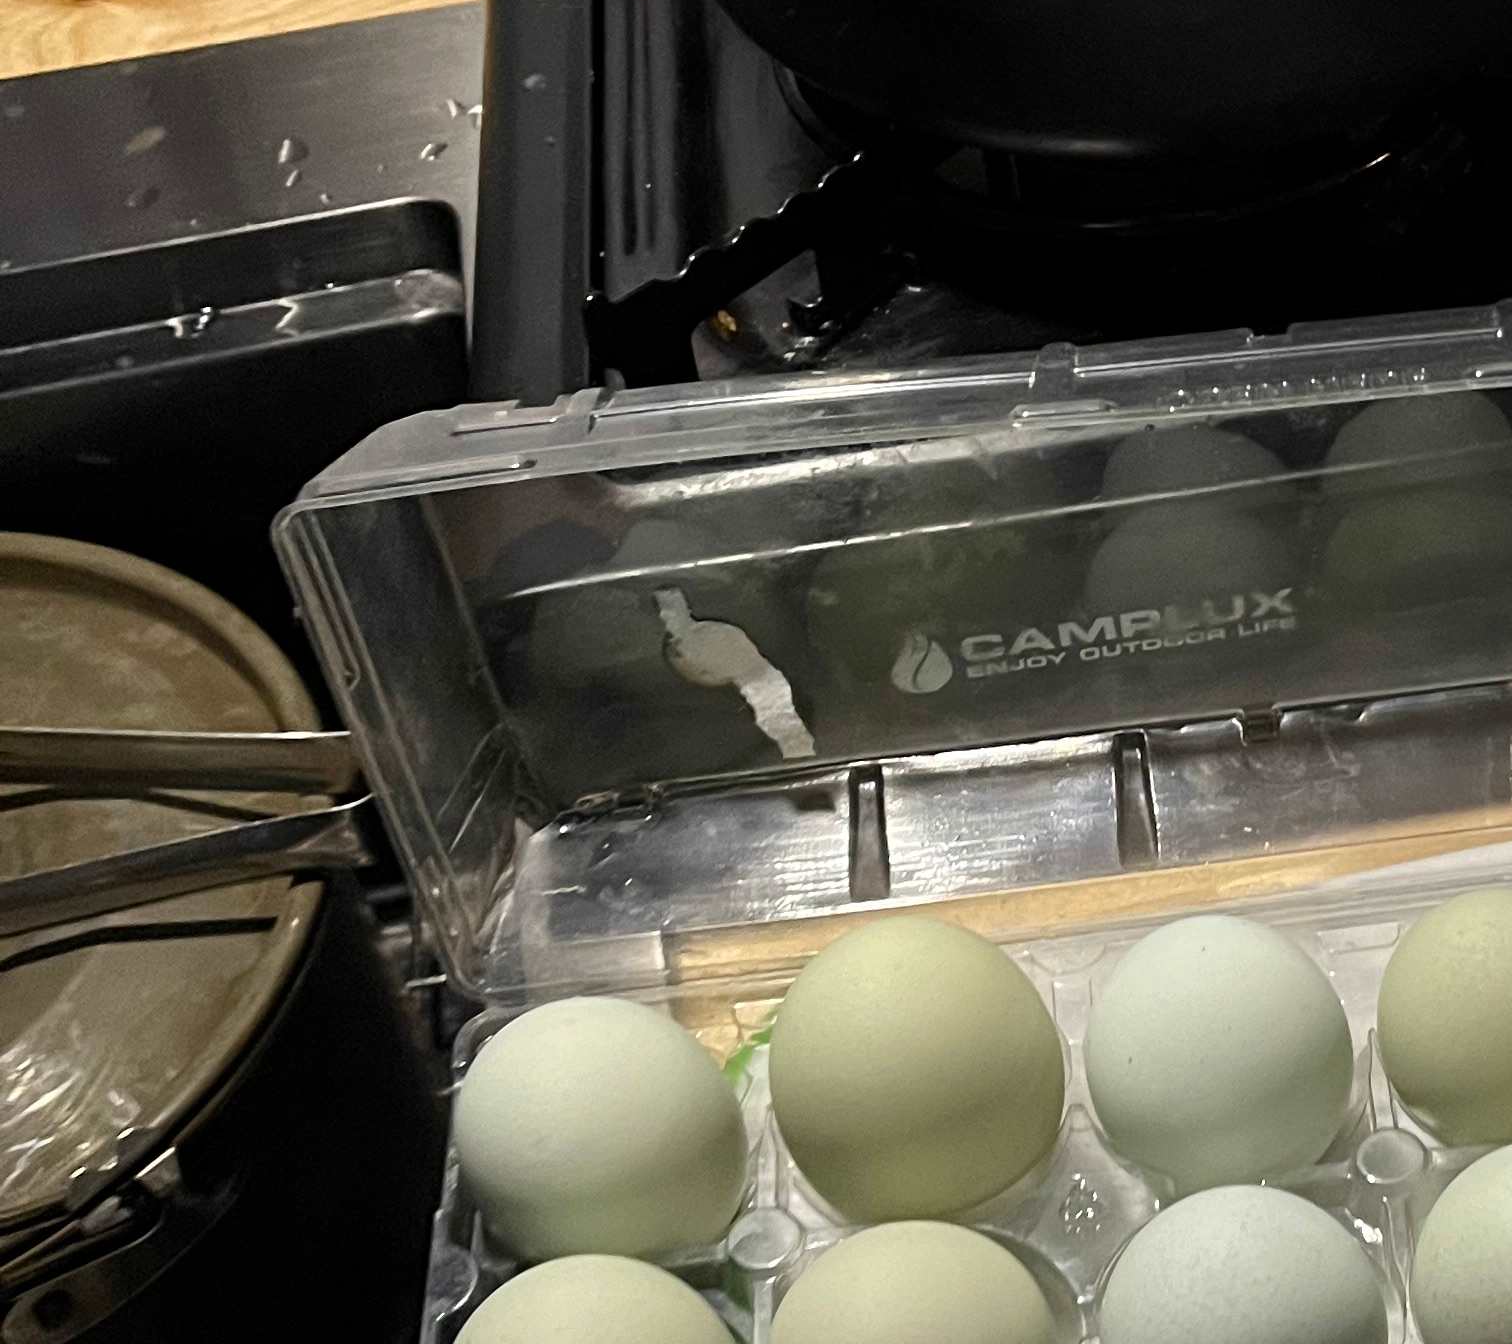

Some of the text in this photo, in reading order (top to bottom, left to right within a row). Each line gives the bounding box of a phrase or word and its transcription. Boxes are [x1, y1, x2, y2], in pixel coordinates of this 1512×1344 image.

[960, 587, 1294, 662] CAMPLUX
[966, 616, 1297, 679] ENJOY OUTDOOR LIFE
